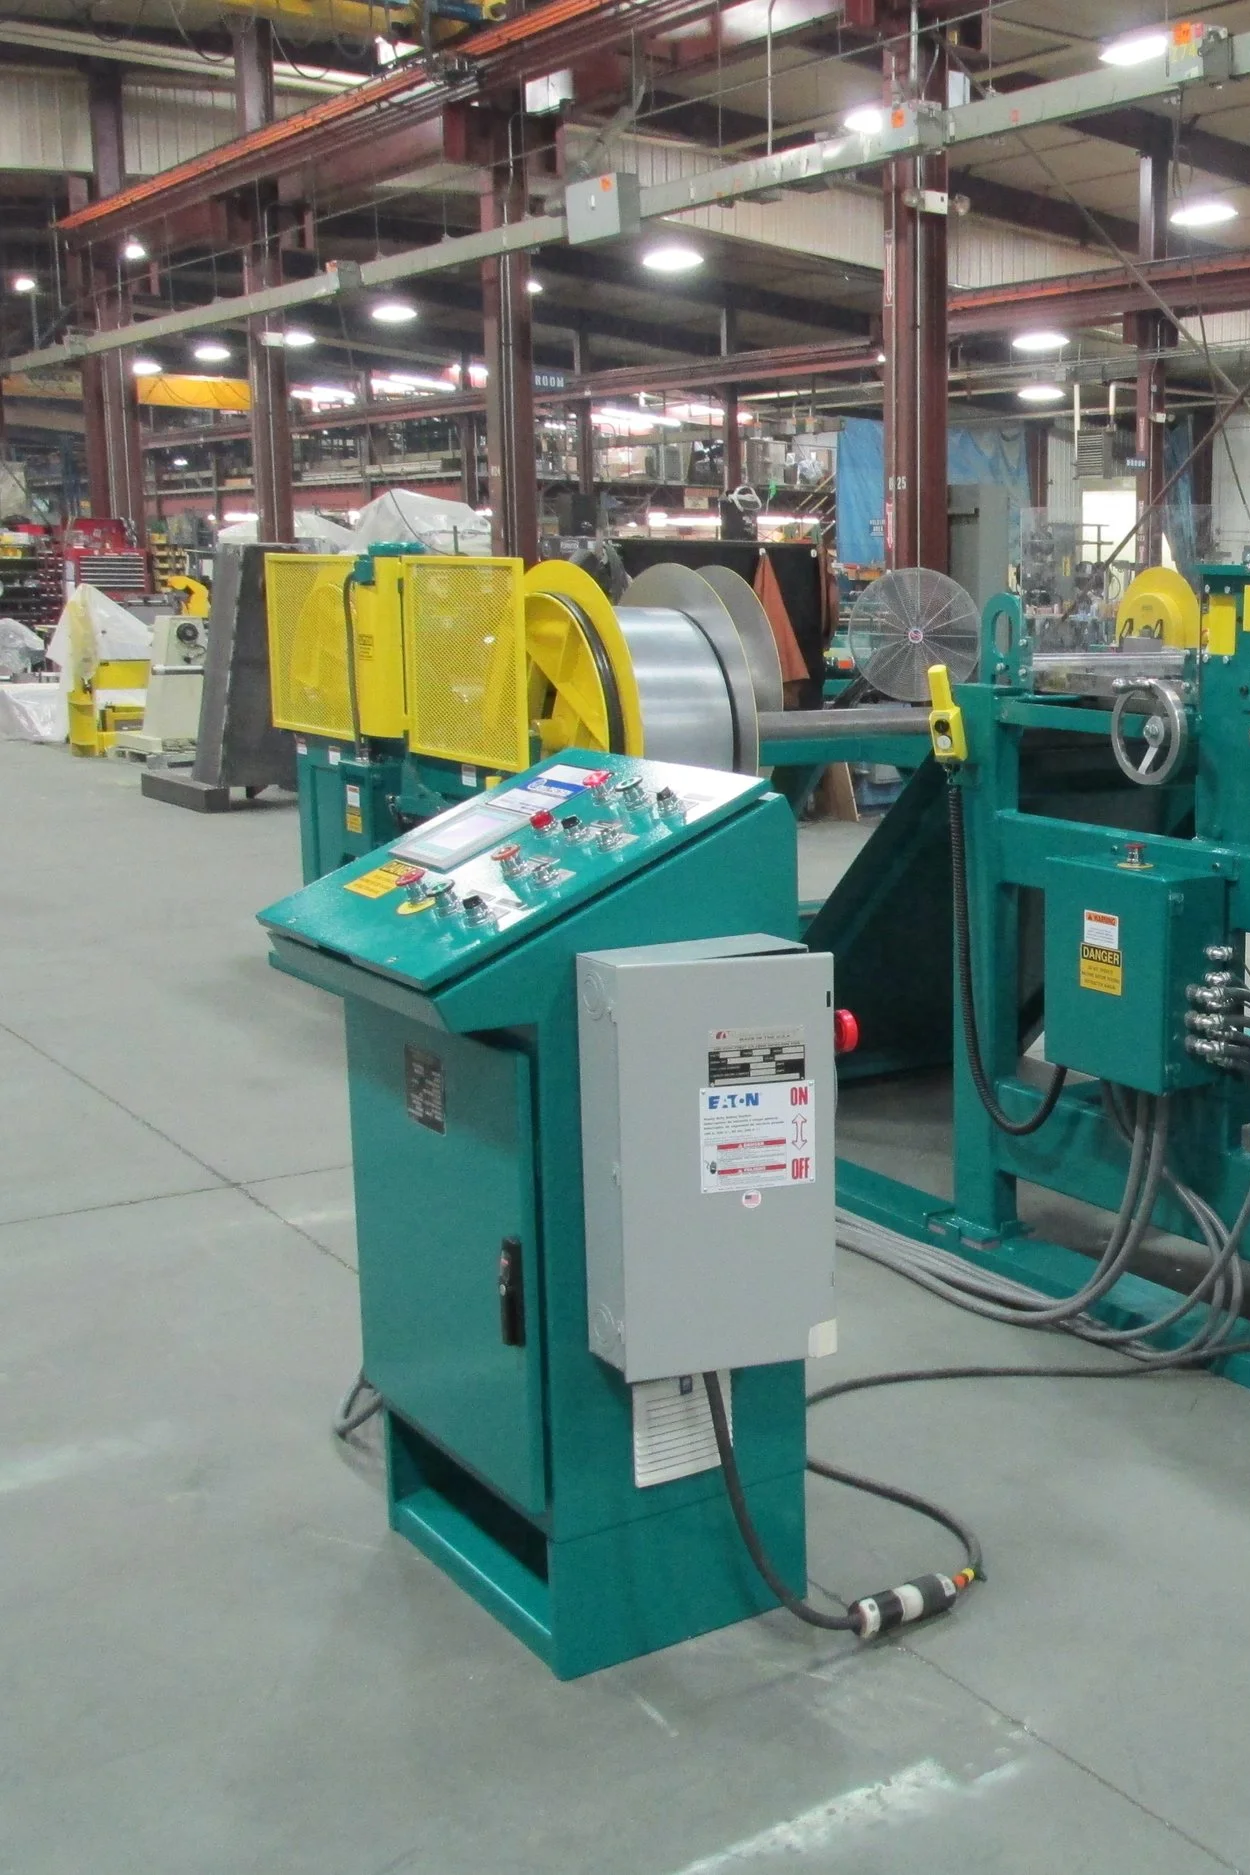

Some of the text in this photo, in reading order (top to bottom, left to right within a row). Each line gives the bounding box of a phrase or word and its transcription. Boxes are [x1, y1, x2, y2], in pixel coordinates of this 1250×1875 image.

[1083, 946, 1120, 965] DANGER
[708, 1087, 808, 1110] EATON ON
[792, 1157, 810, 1180] OFF
